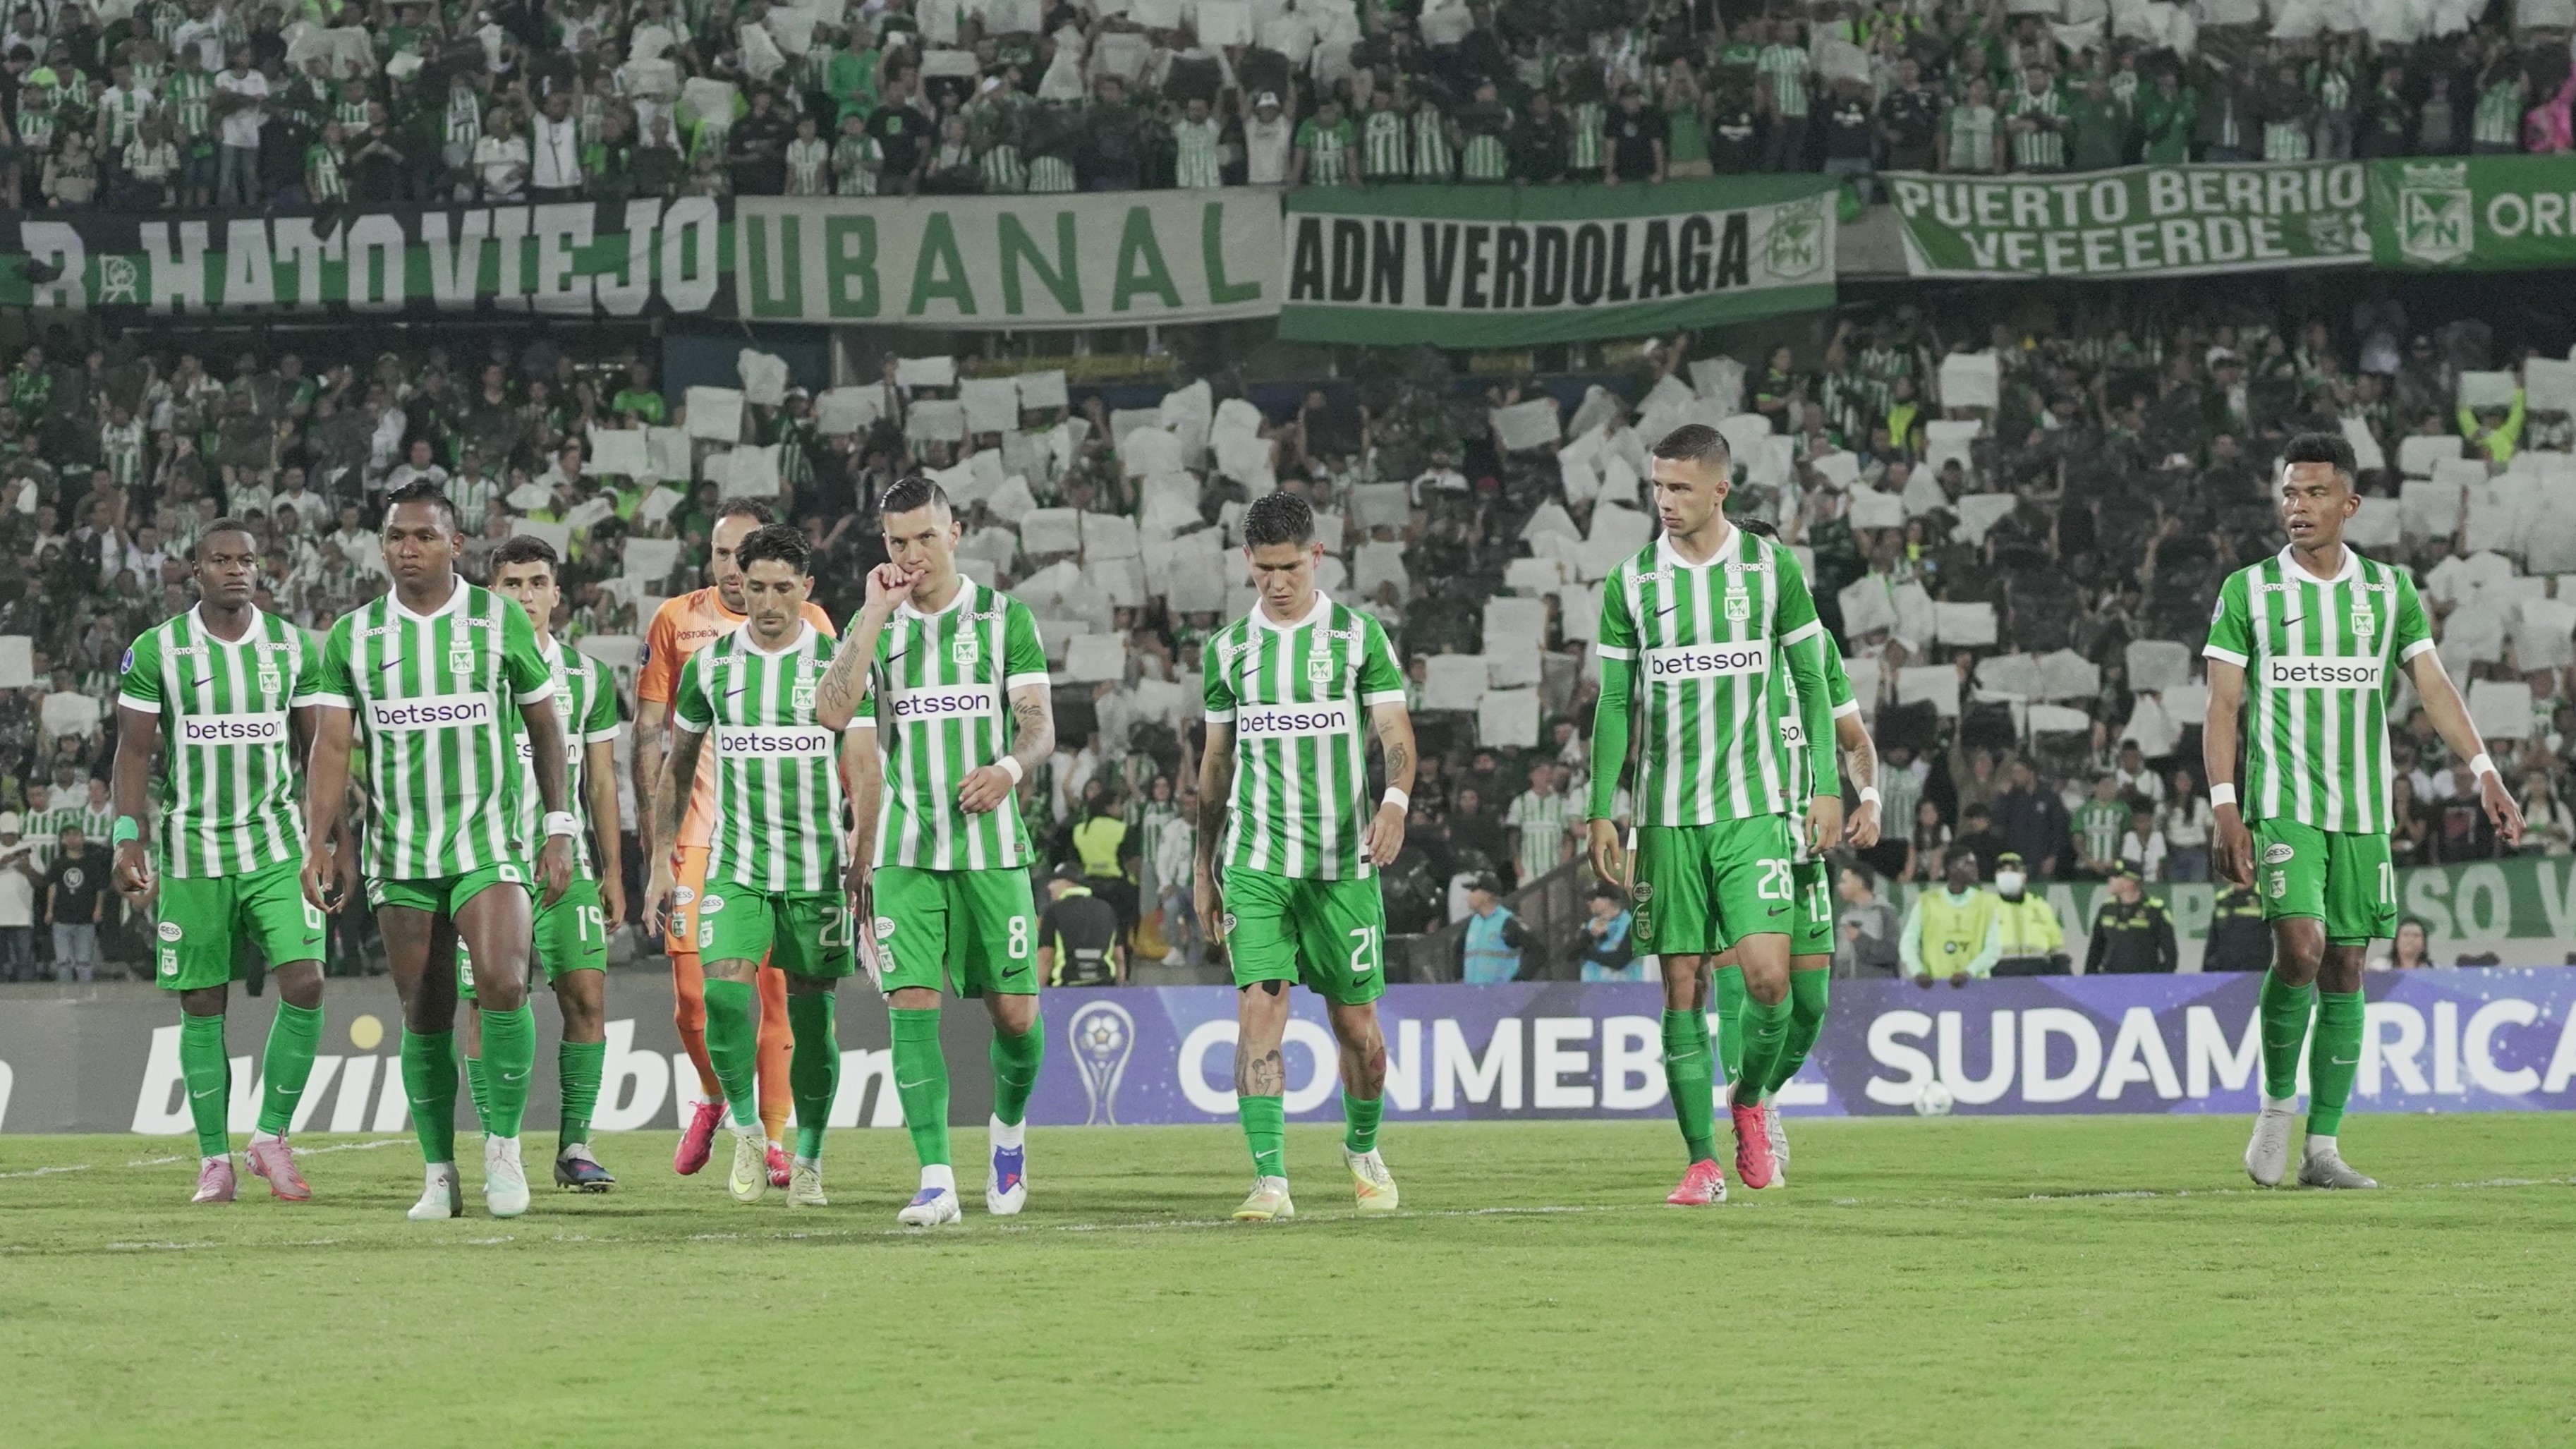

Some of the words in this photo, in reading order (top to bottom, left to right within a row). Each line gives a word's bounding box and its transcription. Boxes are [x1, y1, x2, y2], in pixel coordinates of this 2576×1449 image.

[1893, 178, 2129, 227] PUERTO
[2148, 163, 2365, 215] BERRIO
[1290, 216, 1406, 304] ADN
[1421, 212, 1750, 308] VERDOLAGA
[1652, 651, 1762, 674] betsson
[2273, 662, 2380, 682] betsson
[375, 703, 487, 724] betsson
[887, 694, 990, 716] betsson
[1240, 711, 1346, 732] betsson
[186, 720, 282, 739] betsson
[721, 732, 826, 751] betsson
[1756, 859, 1792, 900] 28
[1806, 880, 1832, 923] 13
[576, 905, 606, 944] 19
[1008, 916, 1028, 959] 8
[1349, 925, 1377, 972] 21
[1178, 1016, 1828, 1113] CONMEB
[1866, 998, 2576, 1105] SUDAMRIC
